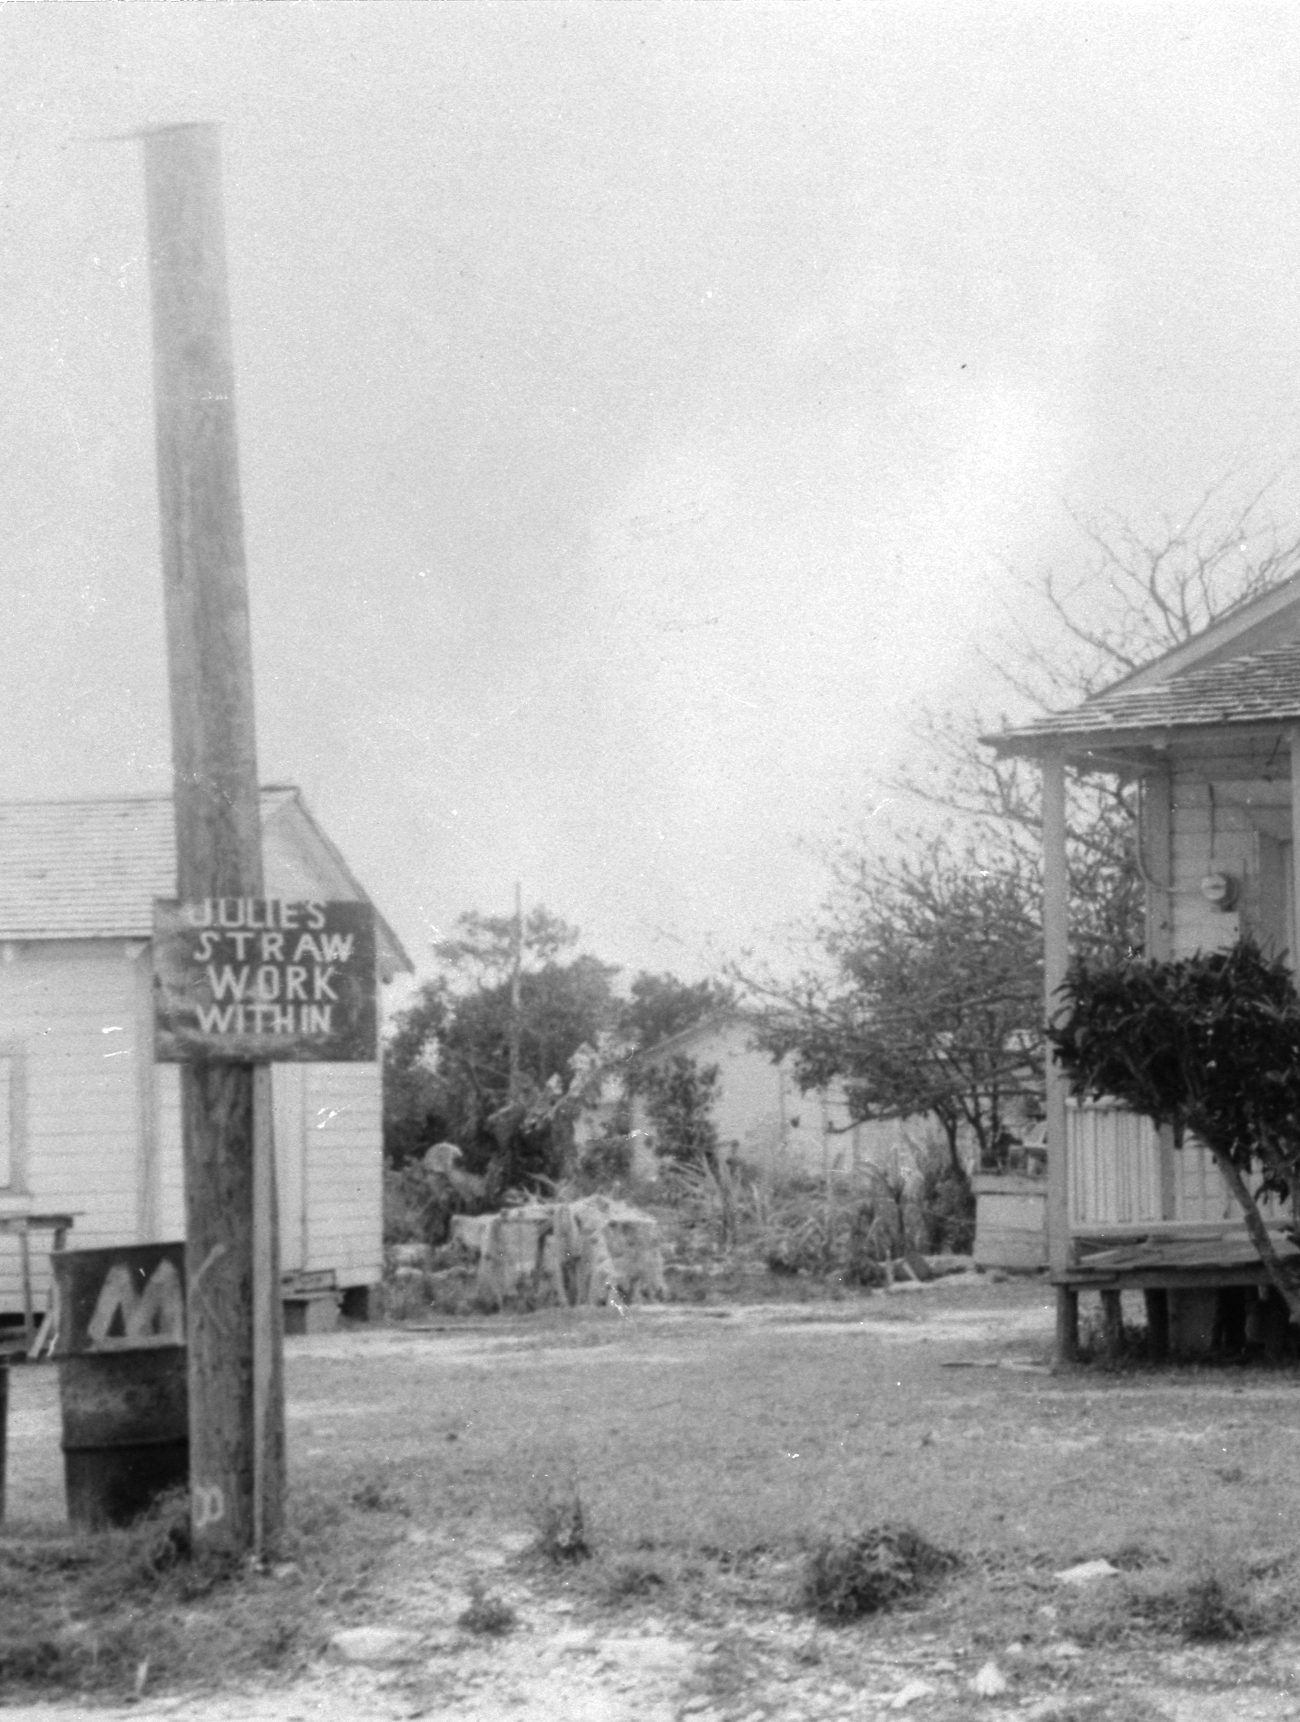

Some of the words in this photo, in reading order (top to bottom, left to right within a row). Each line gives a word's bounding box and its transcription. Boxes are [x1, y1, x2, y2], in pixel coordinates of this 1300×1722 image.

[193, 931, 354, 963] STRAW
[206, 964, 339, 1001] WORK
[196, 1003, 332, 1034] WITHIN
